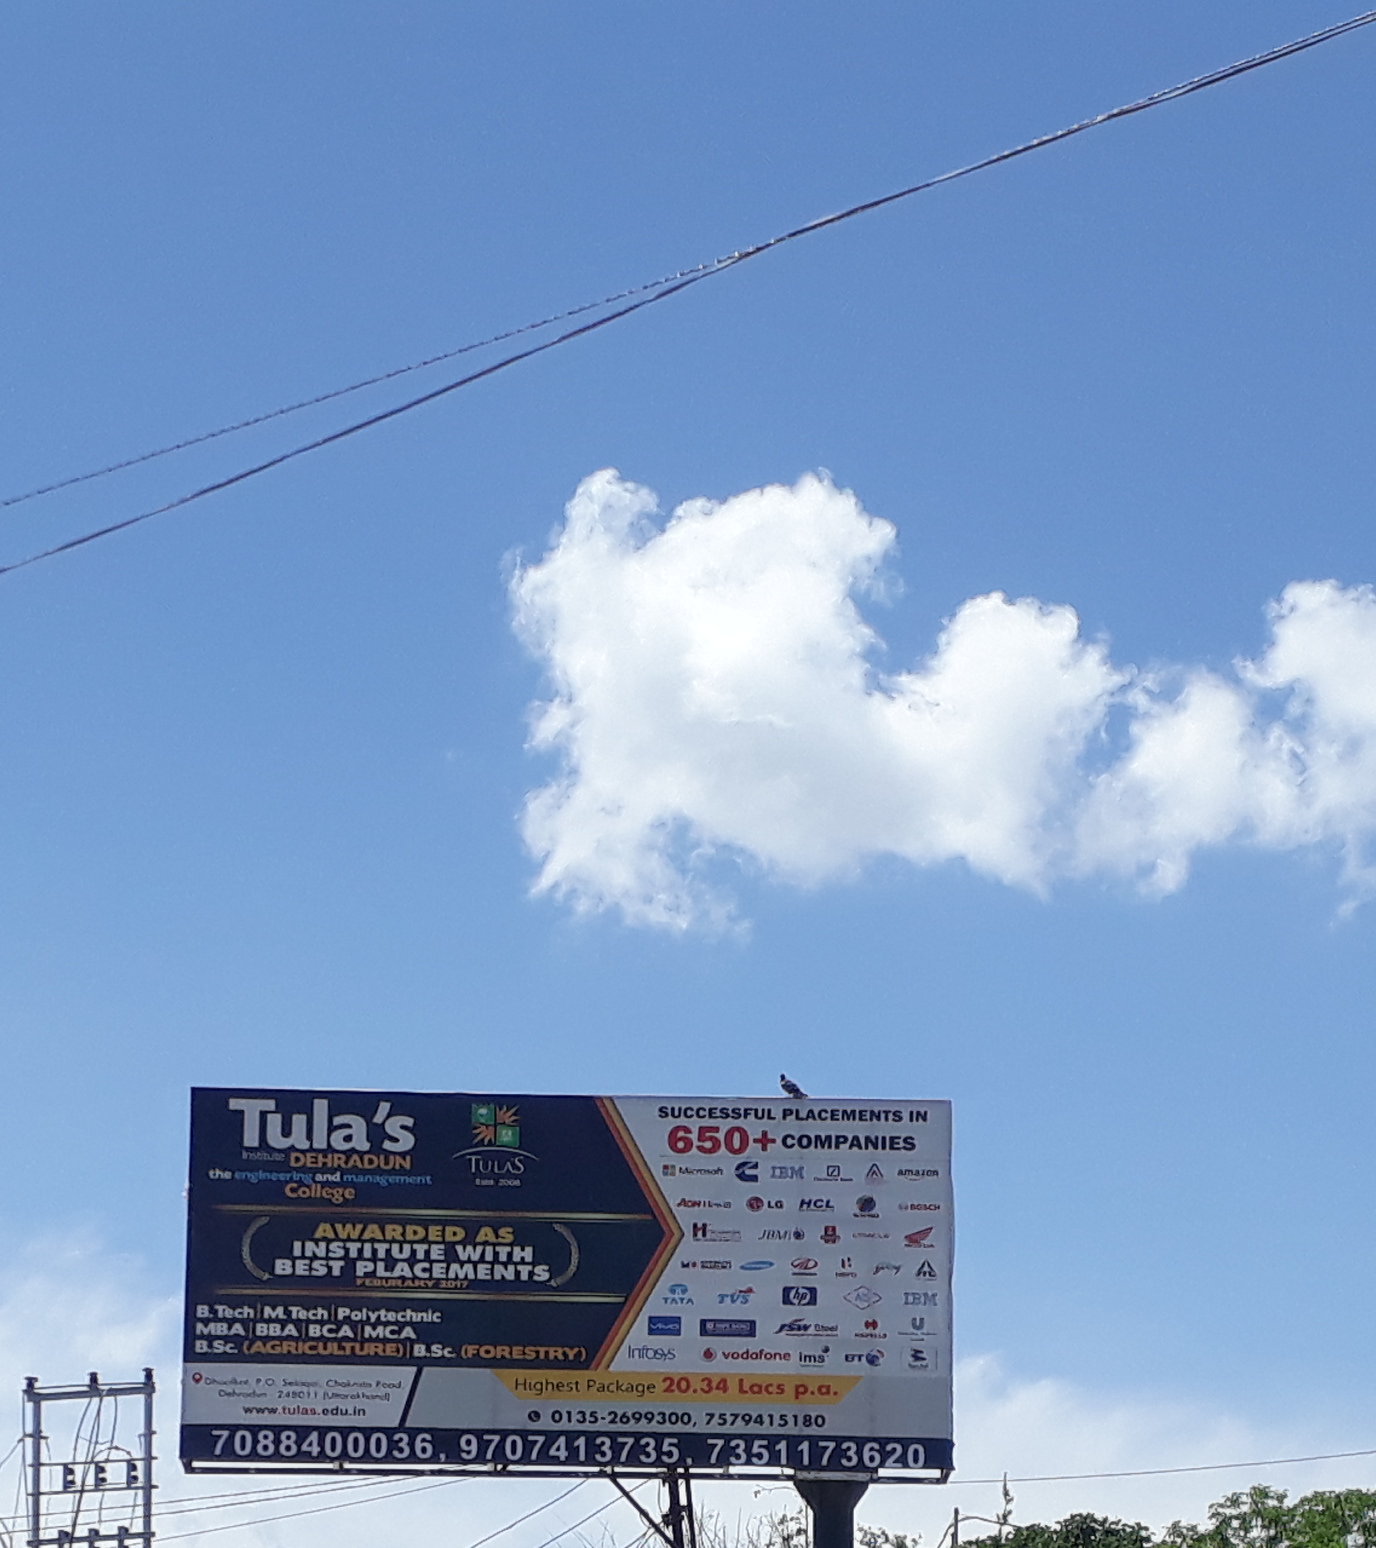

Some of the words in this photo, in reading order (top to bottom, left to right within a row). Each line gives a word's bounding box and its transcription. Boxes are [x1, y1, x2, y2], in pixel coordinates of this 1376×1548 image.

[658, 1106, 776, 1121] SUCCESSFUL
[782, 1108, 903, 1123] PLACEMENTS
[909, 1110, 928, 1123] IN
[228, 1097, 416, 1152] Tula's
[667, 1125, 776, 1154] 650+
[781, 1133, 917, 1151] COMPANIES
[289, 1152, 411, 1170] DEHRADUN
[208, 1168, 232, 1180] the
[235, 1170, 313, 1184] engineering
[315, 1171, 341, 1182] and
[343, 1173, 432, 1187] management
[770, 1165, 804, 1179] IBM
[284, 1183, 355, 1204] College
[767, 1200, 784, 1209] LG
[799, 1199, 834, 1209] HCL
[314, 1222, 466, 1242] AWARDED
[475, 1225, 514, 1243] AS
[292, 1240, 445, 1261] INSTITUTE
[455, 1244, 533, 1263] WITH
[274, 1258, 345, 1277] BEST
[355, 1260, 551, 1282] PLACEMENTS
[662, 1297, 694, 1305] TATA
[717, 1293, 751, 1305] TVS
[792, 1287, 809, 1306] hp
[903, 1292, 938, 1306] IBM
[337, 1307, 442, 1323] Polytechnic
[195, 1322, 245, 1336] MBA
[255, 1323, 299, 1337] BBA
[308, 1323, 354, 1338] BCA
[364, 1324, 417, 1339] MCA
[242, 1340, 404, 1358] (AGRICULTURE)
[461, 1343, 587, 1363] (FORESTRY)
[628, 1345, 676, 1361] Infosys
[722, 1349, 791, 1362] vodafone
[515, 1378, 581, 1396] Highest
[586, 1378, 657, 1397] Package
[662, 1376, 729, 1394] 20.34
[738, 1378, 786, 1396] Lacs
[794, 1382, 839, 1400] p.a.
[242, 1404, 367, 1418] www.tulas.edu.in
[551, 1410, 697, 1427] 0135-2699300,
[705, 1412, 826, 1428] 7579415180
[707, 1437, 925, 1469] 7351173620
